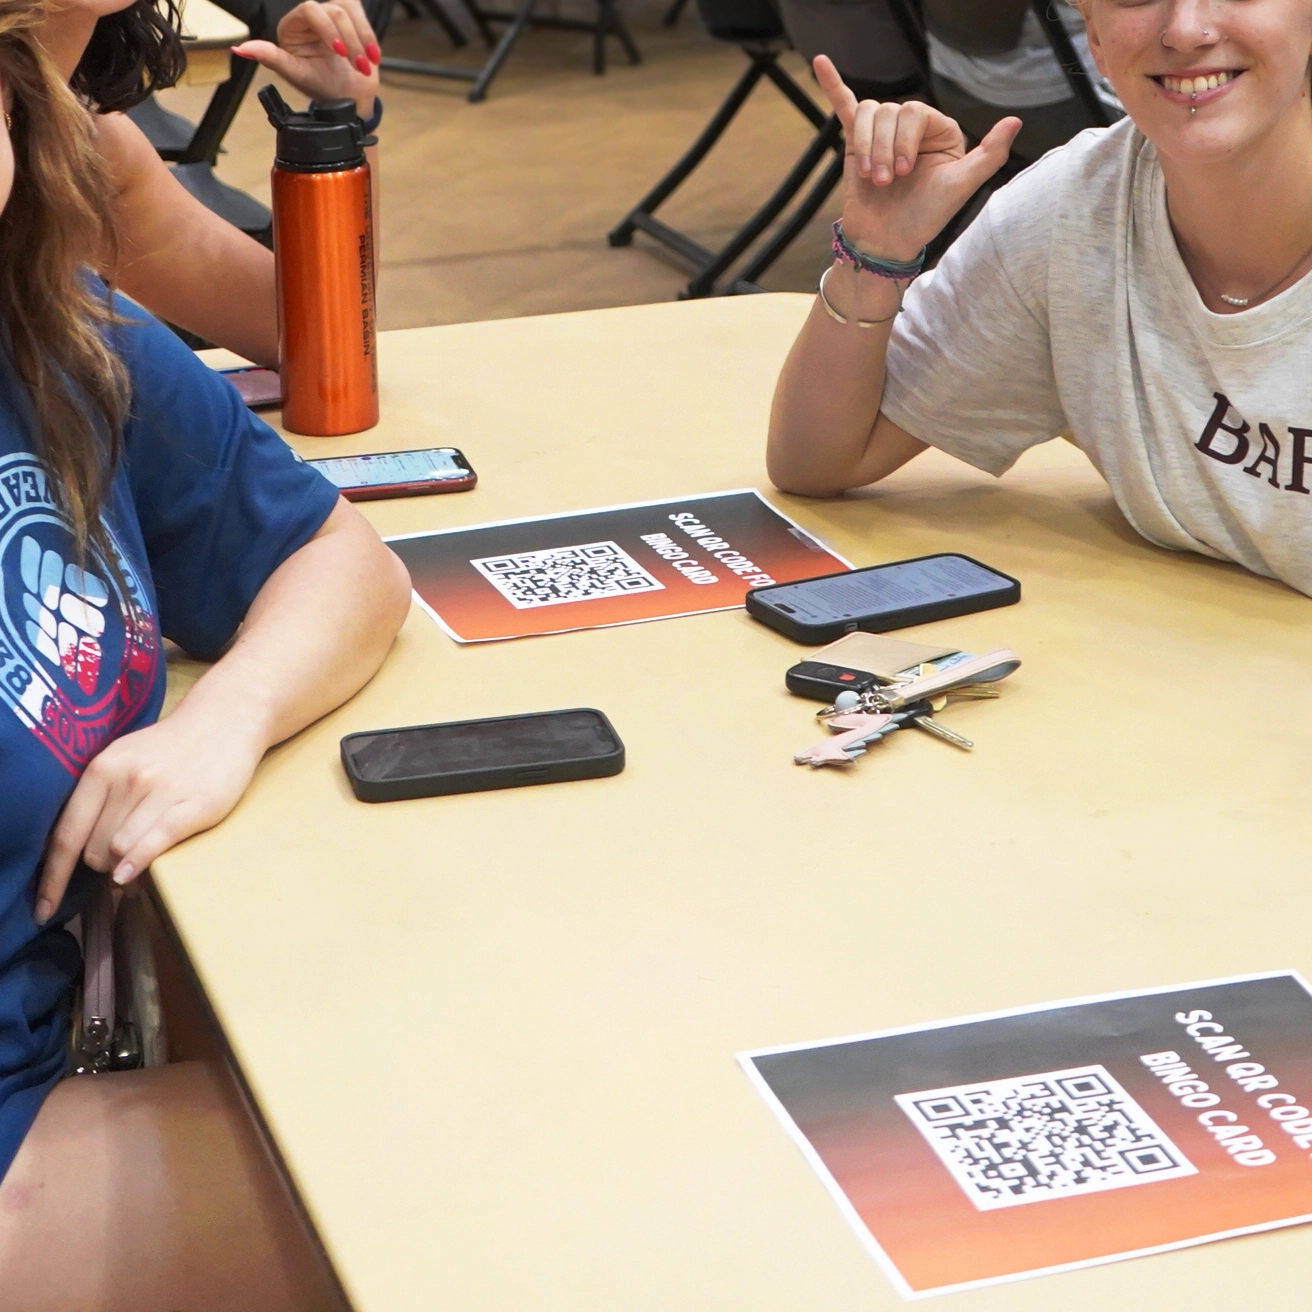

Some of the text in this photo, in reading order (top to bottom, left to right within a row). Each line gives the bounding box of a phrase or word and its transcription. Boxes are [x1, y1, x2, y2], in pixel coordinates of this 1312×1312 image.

[358, 234, 370, 357] PERMIAN BASIN
[640, 532, 719, 585] BINGO CARD
[668, 512, 777, 587] SCAN QR CODE FO
[1175, 1009, 1250, 1062] SCAN
[1225, 1062, 1279, 1093] QR
[1139, 1050, 1277, 1167] BINGO CARD
